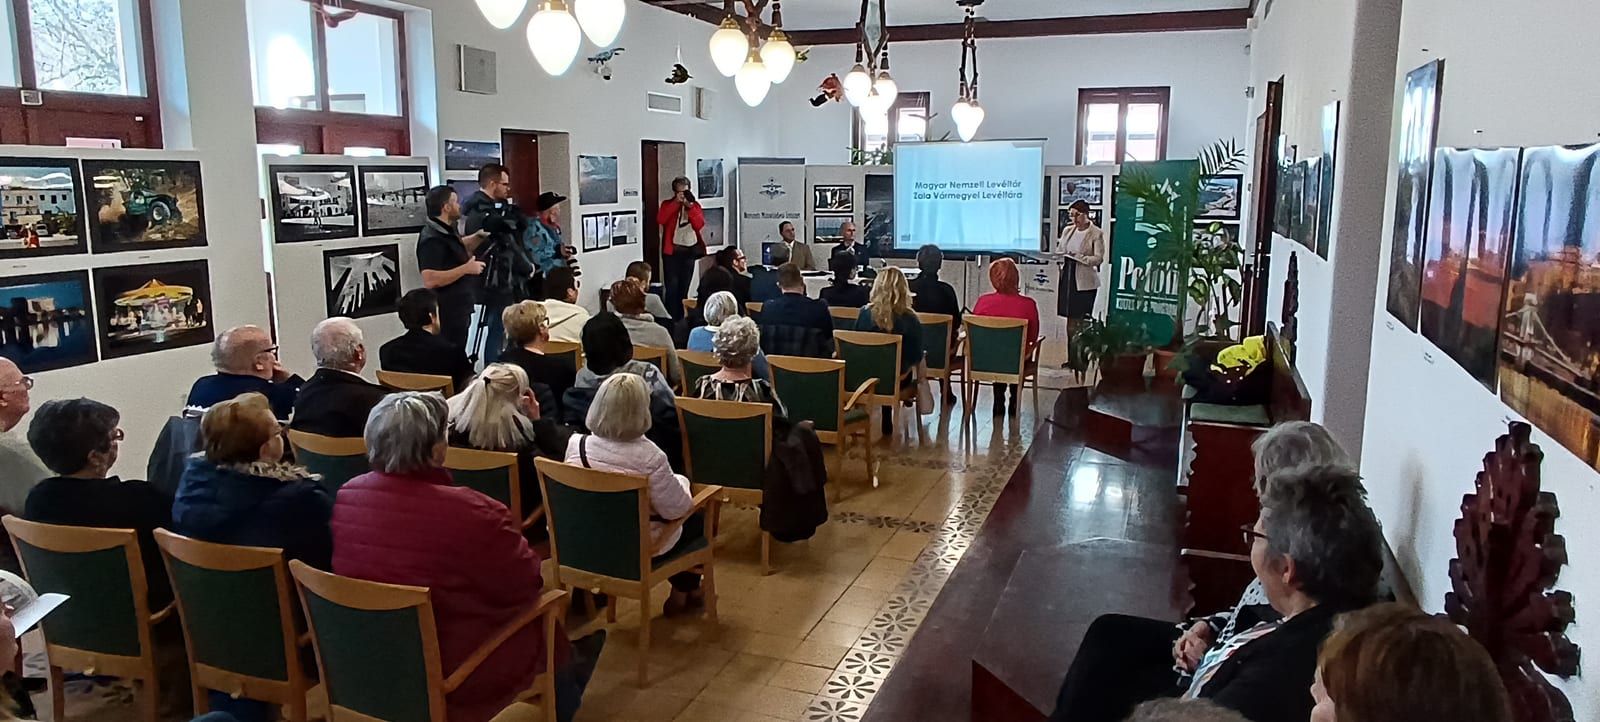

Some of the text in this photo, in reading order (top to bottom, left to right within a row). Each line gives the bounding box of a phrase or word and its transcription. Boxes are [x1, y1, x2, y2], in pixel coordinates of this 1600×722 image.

[914, 179, 1022, 190] Magyar Nemzeti Levéltár
[913, 191, 1023, 201] Zala Vármegyei Levéltára
